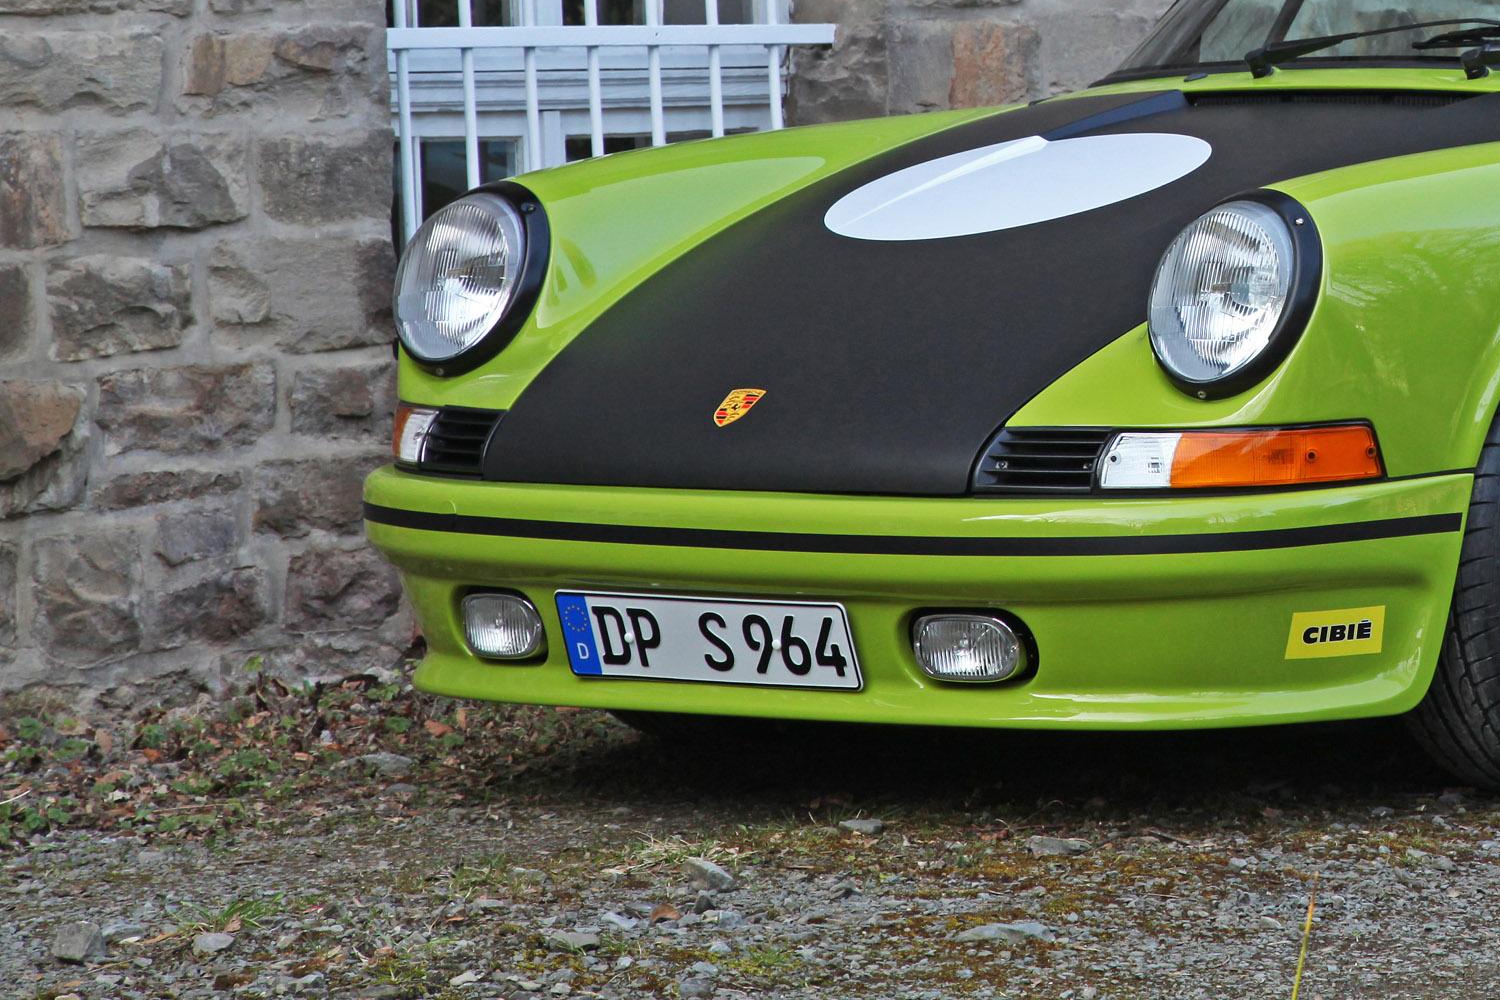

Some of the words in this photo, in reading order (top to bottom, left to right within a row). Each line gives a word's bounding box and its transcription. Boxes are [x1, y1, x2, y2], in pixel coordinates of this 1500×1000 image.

[576, 642, 590, 660] D
[591, 606, 661, 667] DP
[1303, 619, 1372, 644] CIBIÉ
